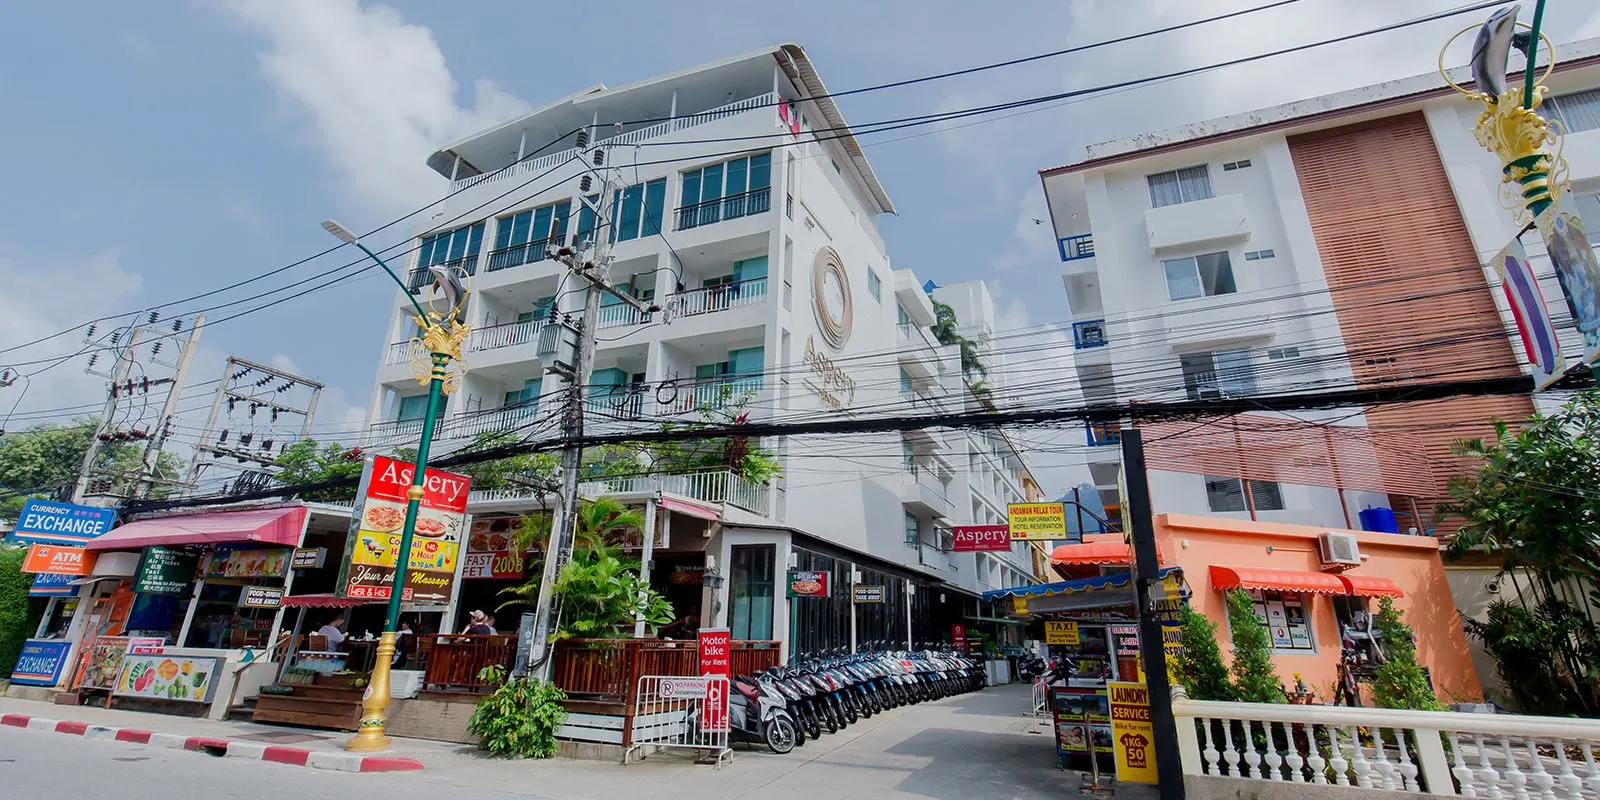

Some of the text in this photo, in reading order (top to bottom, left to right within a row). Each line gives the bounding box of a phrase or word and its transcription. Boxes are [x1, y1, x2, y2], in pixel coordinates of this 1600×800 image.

[30, 504, 71, 515] CURRENCY
[1010, 506, 1063, 515] ANDAMAN RELAX TOUR
[23, 514, 104, 535] EXCHANGE
[956, 529, 1008, 544] Aspery
[52, 551, 82, 563] ATM
[417, 550, 434, 559] Hour
[350, 564, 381, 585] Your
[411, 572, 449, 588] Massage
[366, 587, 373, 595] &
[1050, 622, 1073, 631] TAXI
[701, 636, 728, 645] Motor
[1120, 637, 1139, 646] LAUN
[704, 646, 724, 656] bike
[16, 656, 57, 674] EXCHANGE
[1110, 687, 1147, 704] LAUNDRY
[1113, 707, 1150, 720] SERVICE
[1128, 748, 1144, 760] 50
